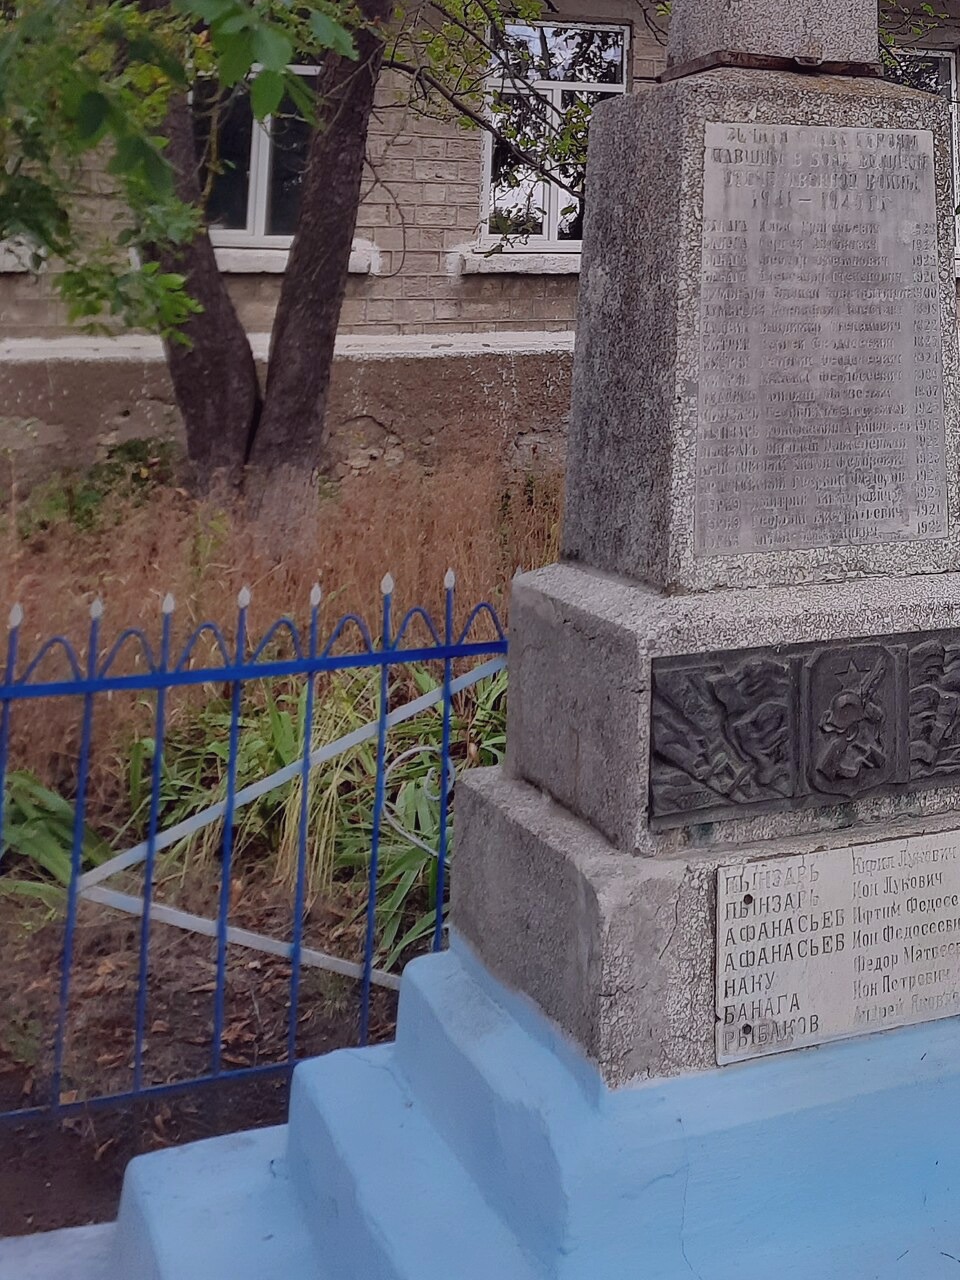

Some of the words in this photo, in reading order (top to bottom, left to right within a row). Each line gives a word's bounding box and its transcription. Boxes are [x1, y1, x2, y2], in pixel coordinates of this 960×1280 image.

[724, 863, 820, 895] ПЫНЗАРЬ
[724, 888, 820, 921] ПЫНЗАРЬ
[883, 872, 944, 895] Лукович
[723, 993, 801, 1026] БАНАГА
[882, 968, 951, 994] Петрович
[724, 971, 776, 999] НАКУ
[853, 953, 899, 974] Федор
[723, 1014, 820, 1052] РЫБАКОВ
